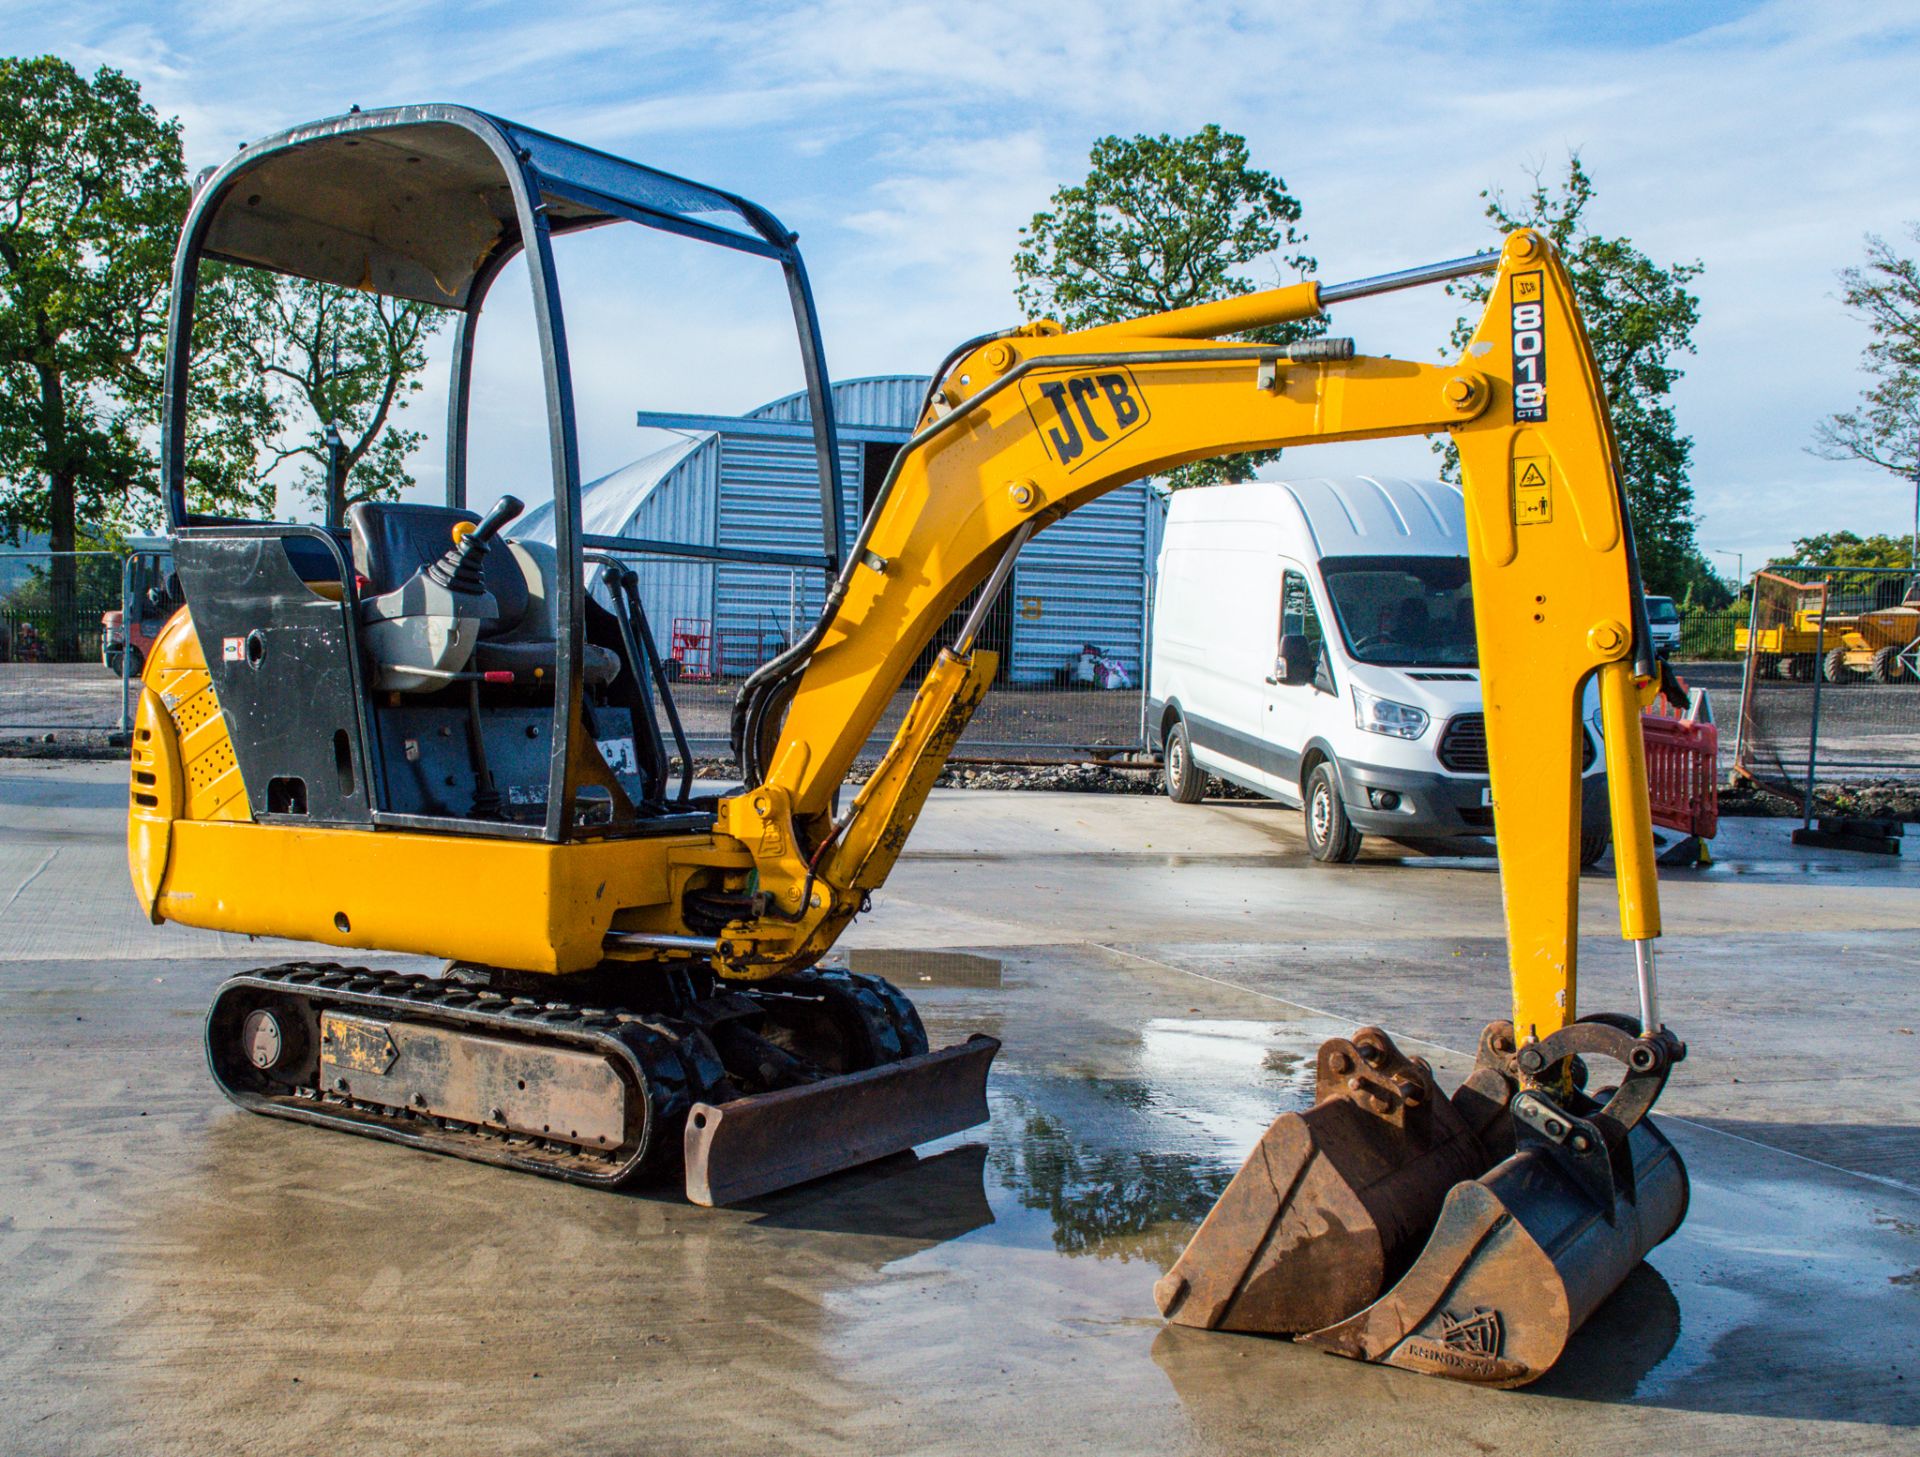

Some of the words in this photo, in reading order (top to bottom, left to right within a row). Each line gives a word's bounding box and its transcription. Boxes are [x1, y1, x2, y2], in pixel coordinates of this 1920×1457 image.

[1520, 281, 1536, 295] JCB
[1513, 304, 1543, 409] 8018
[1038, 374, 1140, 466] JCB
[1516, 409, 1542, 418] CTS
